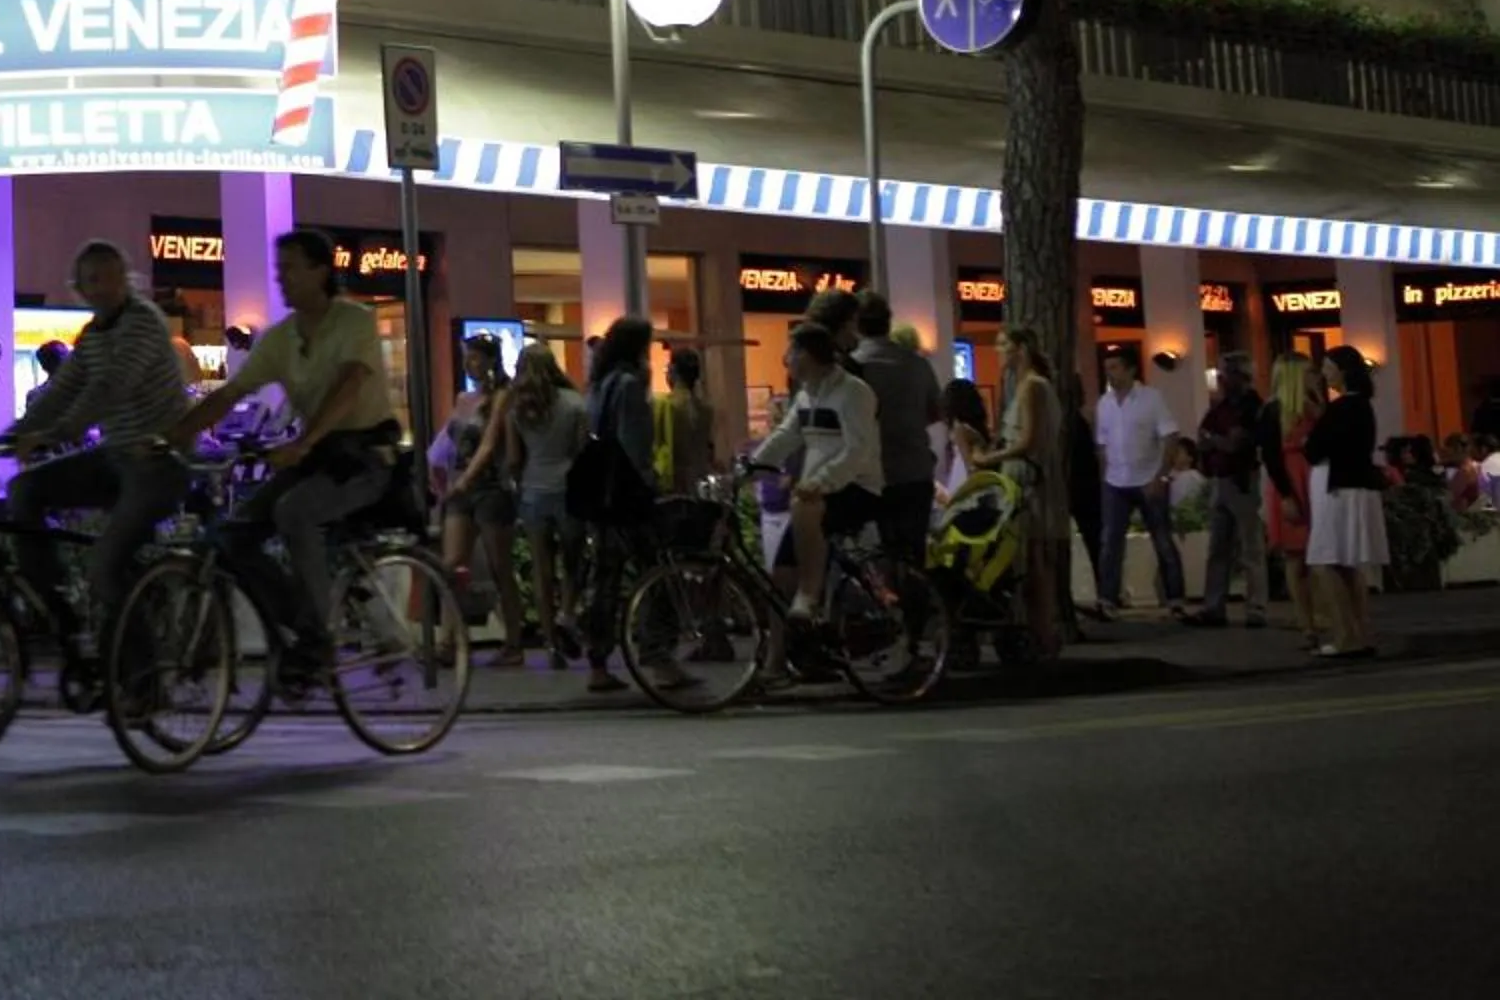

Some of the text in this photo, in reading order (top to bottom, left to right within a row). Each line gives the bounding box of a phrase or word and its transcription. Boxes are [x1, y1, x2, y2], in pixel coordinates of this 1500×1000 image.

[150, 235, 225, 261] VENEZI
[334, 244, 350, 268] in
[1273, 291, 1341, 312] VENEZI
[1404, 285, 1423, 304] in
